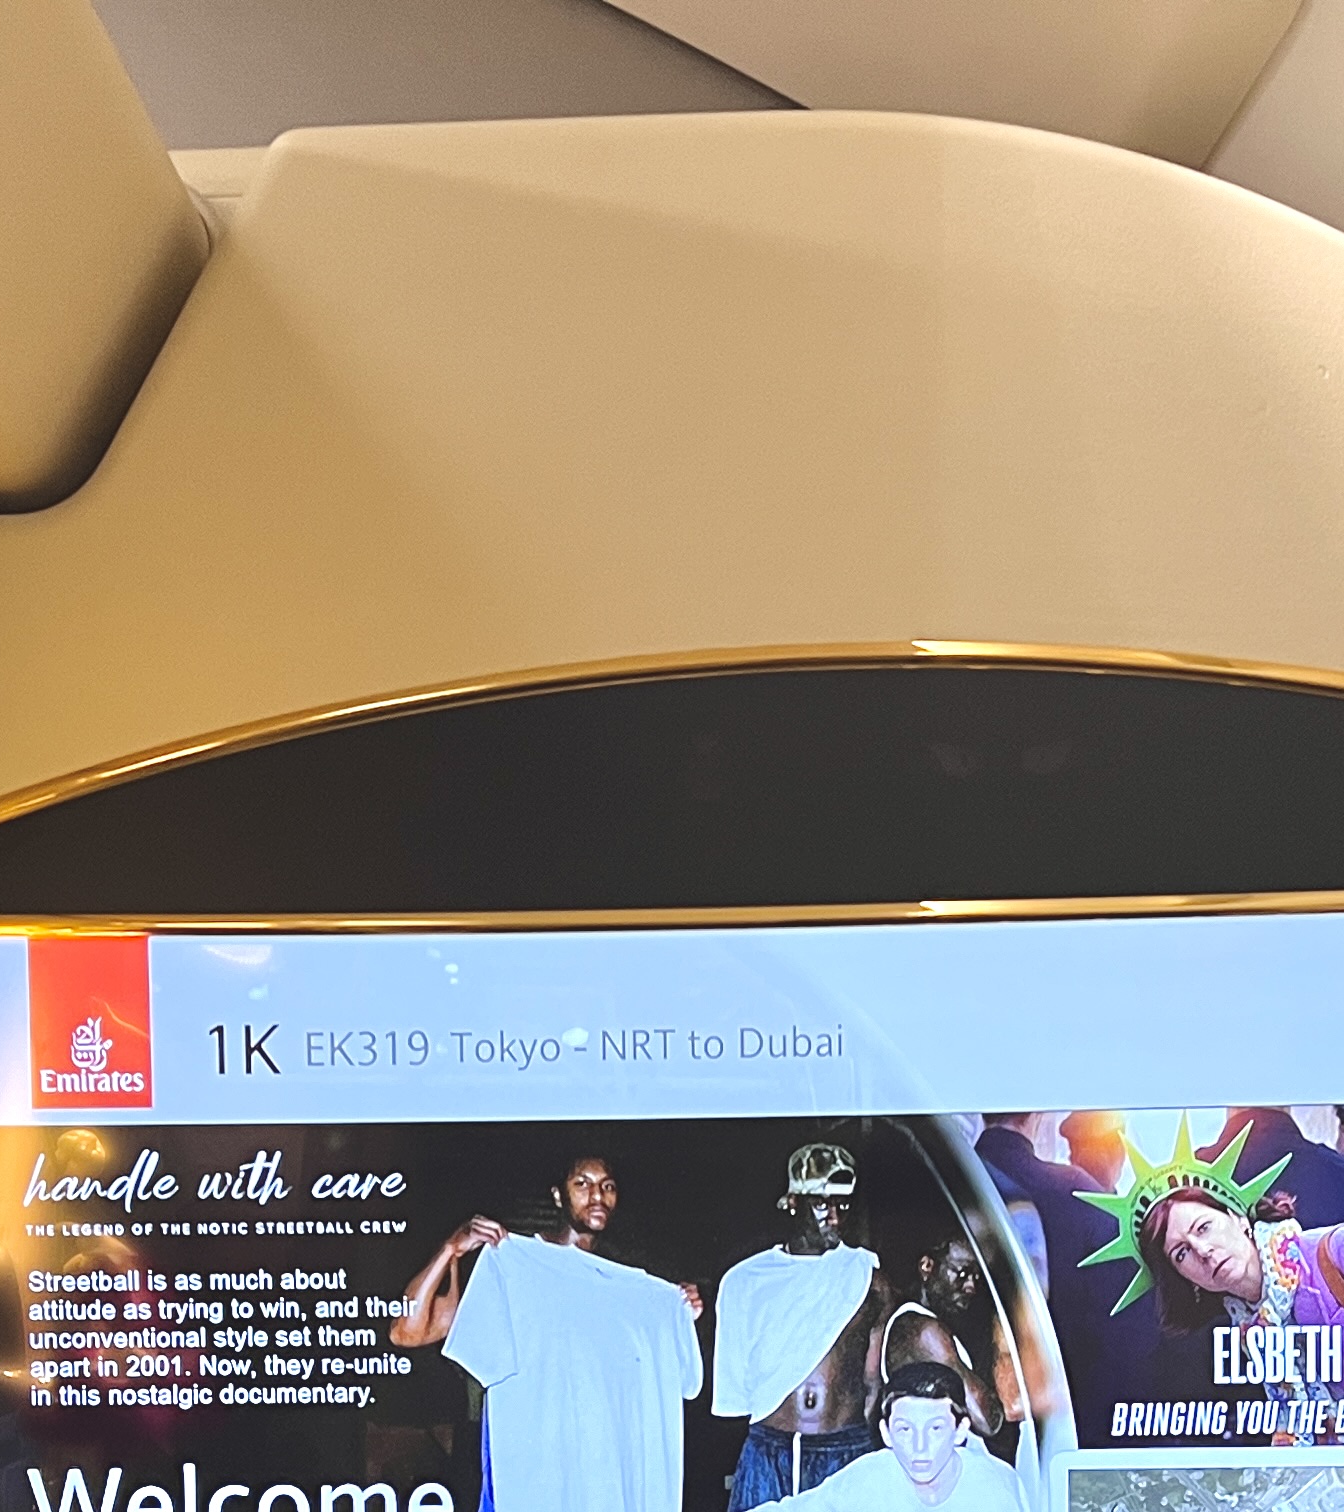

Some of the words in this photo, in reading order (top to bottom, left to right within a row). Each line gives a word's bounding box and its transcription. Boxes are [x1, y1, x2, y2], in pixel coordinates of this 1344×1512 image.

[208, 1023, 282, 1075] 1K
[305, 1030, 431, 1067] EK319
[448, 1029, 561, 1072] Tokyo
[600, 1028, 676, 1062] NRT
[687, 1029, 725, 1061] to
[738, 1023, 845, 1060] Dubai
[39, 1068, 145, 1093] Emirates
[22, 1148, 180, 1214] handle
[197, 1149, 294, 1206] with
[311, 1171, 407, 1201] care
[25, 1223, 54, 1237] THE
[61, 1223, 125, 1237] LEGEND
[131, 1223, 153, 1236] OF
[159, 1222, 191, 1236] THE
[197, 1222, 248, 1236] NOTIC
[255, 1221, 354, 1235] STREETBALL
[359, 1220, 407, 1234] CREW
[27, 1269, 140, 1292] Streetball
[147, 1270, 168, 1292] is
[174, 1273, 203, 1291] as
[209, 1268, 273, 1291] much
[279, 1268, 347, 1291] about
[28, 1298, 117, 1321] attitude
[122, 1302, 153, 1321] as
[157, 1297, 224, 1325] trying
[230, 1297, 254, 1319] to
[259, 1297, 307, 1322] win,
[314, 1295, 359, 1319] and
[364, 1294, 417, 1318] their
[29, 1326, 207, 1350] unconventional
[213, 1325, 269, 1353] style
[274, 1325, 312, 1348] set
[317, 1324, 376, 1347] them
[29, 1357, 90, 1383] apart
[94, 1354, 119, 1378] in
[125, 1354, 191, 1378] 2001.
[199, 1354, 257, 1380] Now,
[263, 1353, 315, 1382] they
[321, 1352, 412, 1376] re-unite
[1213, 1325, 1343, 1385] ELSBETH
[30, 1384, 52, 1407] in
[58, 1384, 101, 1407] this
[108, 1382, 213, 1411] nostalgic
[218, 1382, 376, 1409] documentary.
[1110, 1401, 1229, 1437] BRINGING
[1235, 1399, 1281, 1435] YOU
[1286, 1399, 1331, 1435] THE
